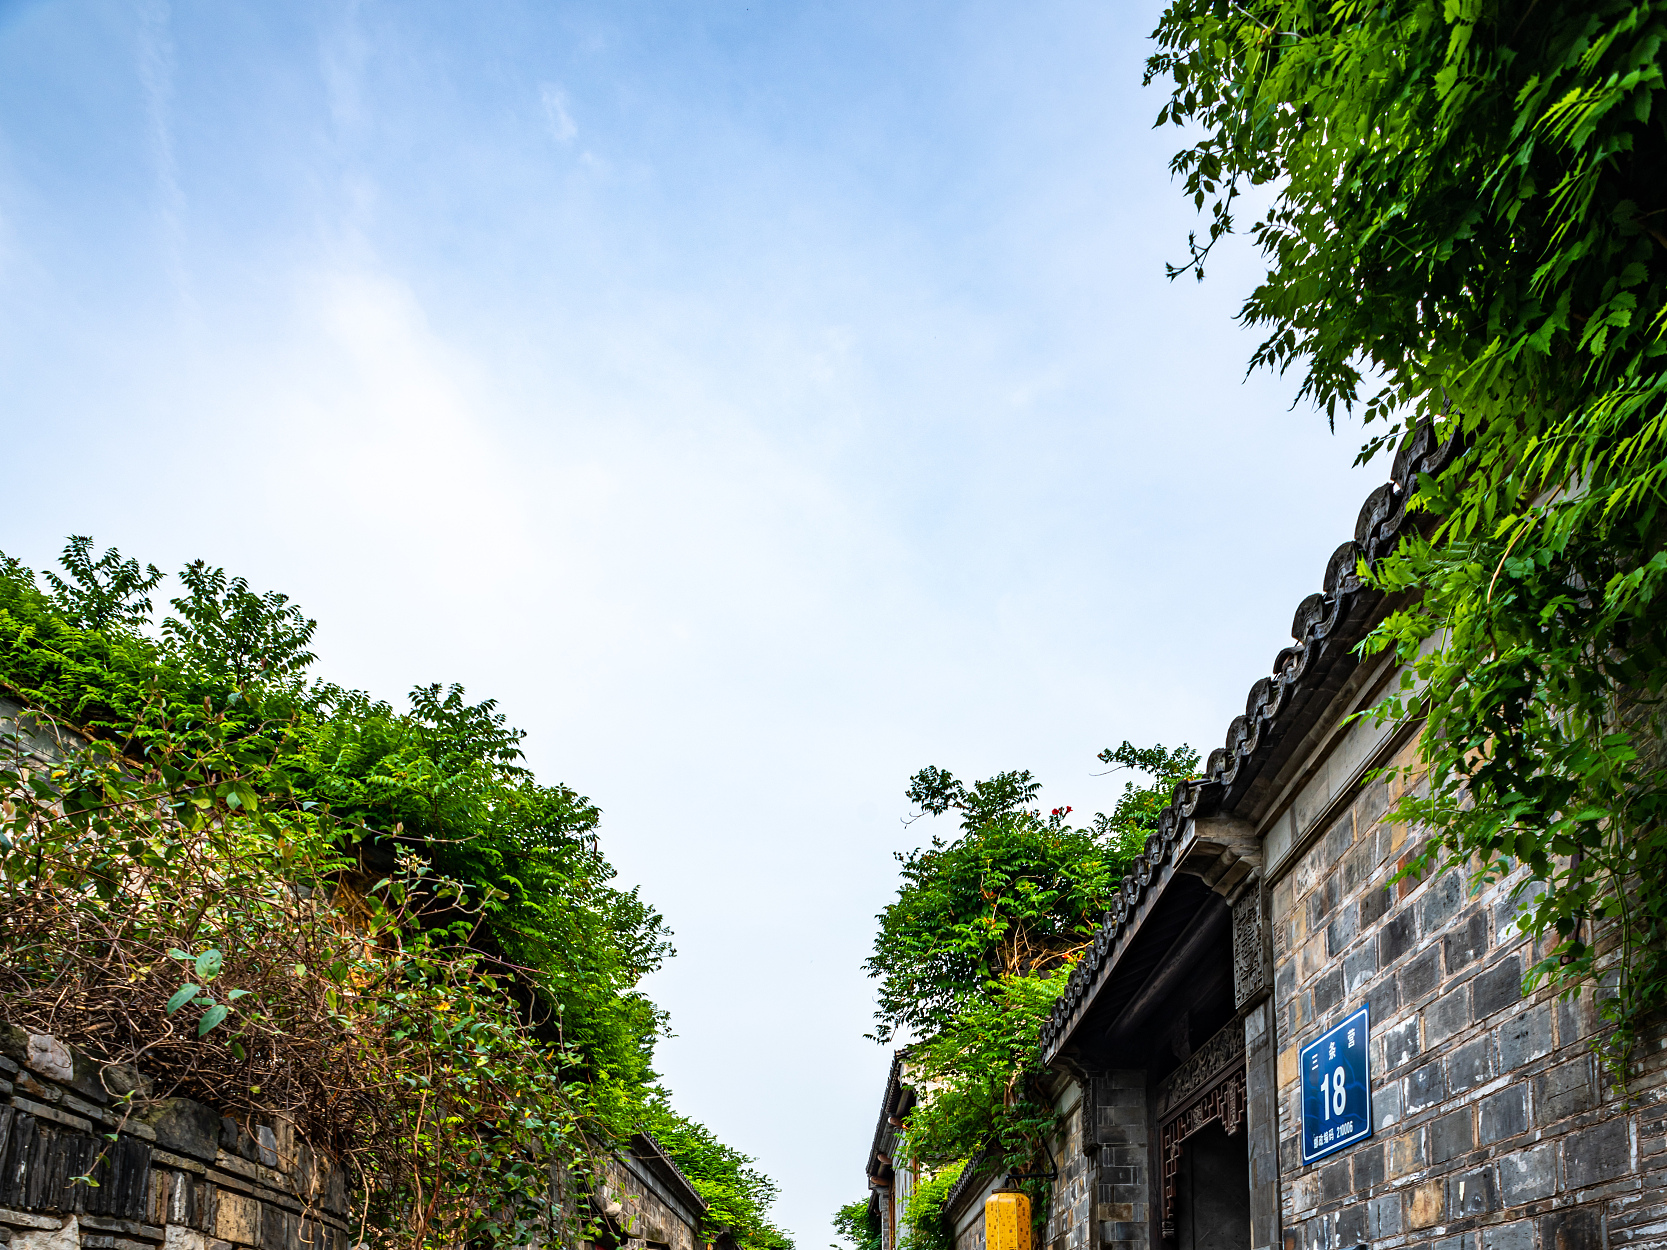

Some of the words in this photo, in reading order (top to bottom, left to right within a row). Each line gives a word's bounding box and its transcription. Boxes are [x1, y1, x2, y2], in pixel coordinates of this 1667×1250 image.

[1311, 1028, 1356, 1071] 三条营
[1320, 1065, 1347, 1121] 18
